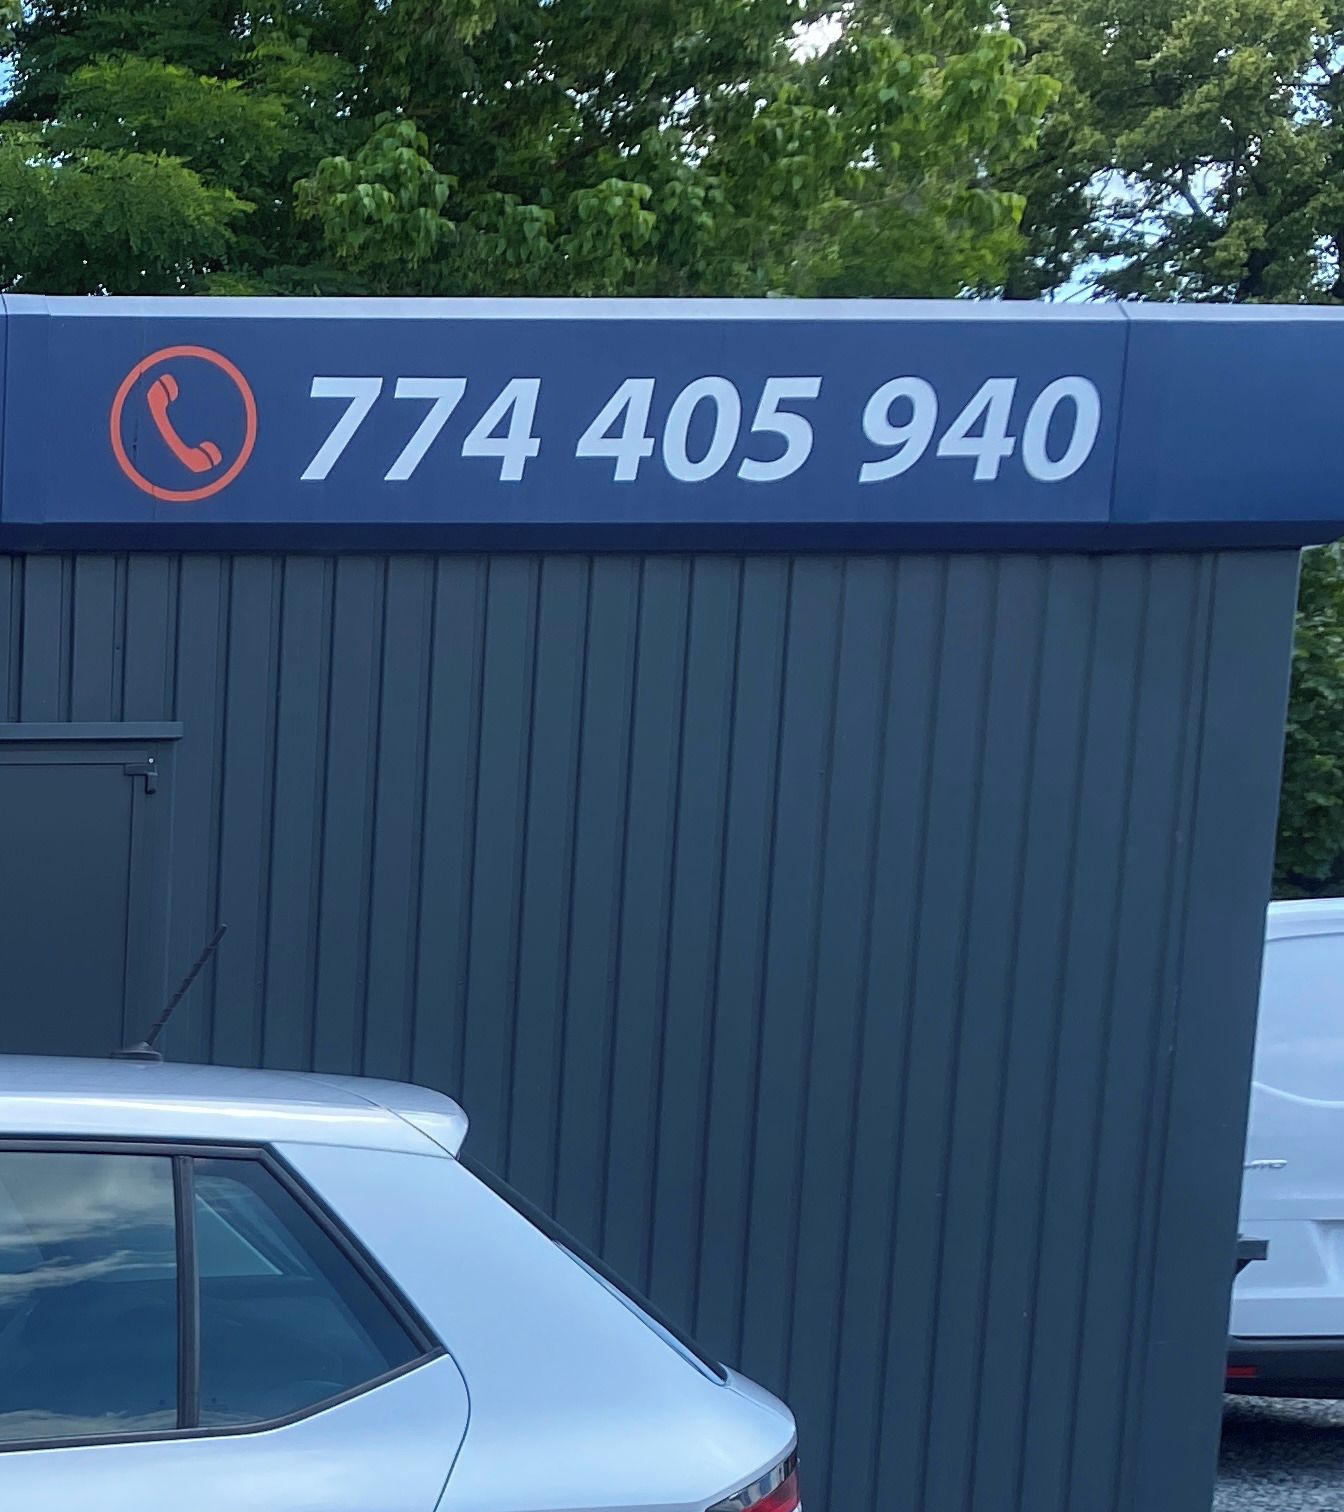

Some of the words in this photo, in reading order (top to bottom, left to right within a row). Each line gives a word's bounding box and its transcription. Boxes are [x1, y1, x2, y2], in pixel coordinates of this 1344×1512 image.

[299, 375, 542, 482] 774
[574, 375, 823, 483] 405
[858, 375, 1101, 484] 940
